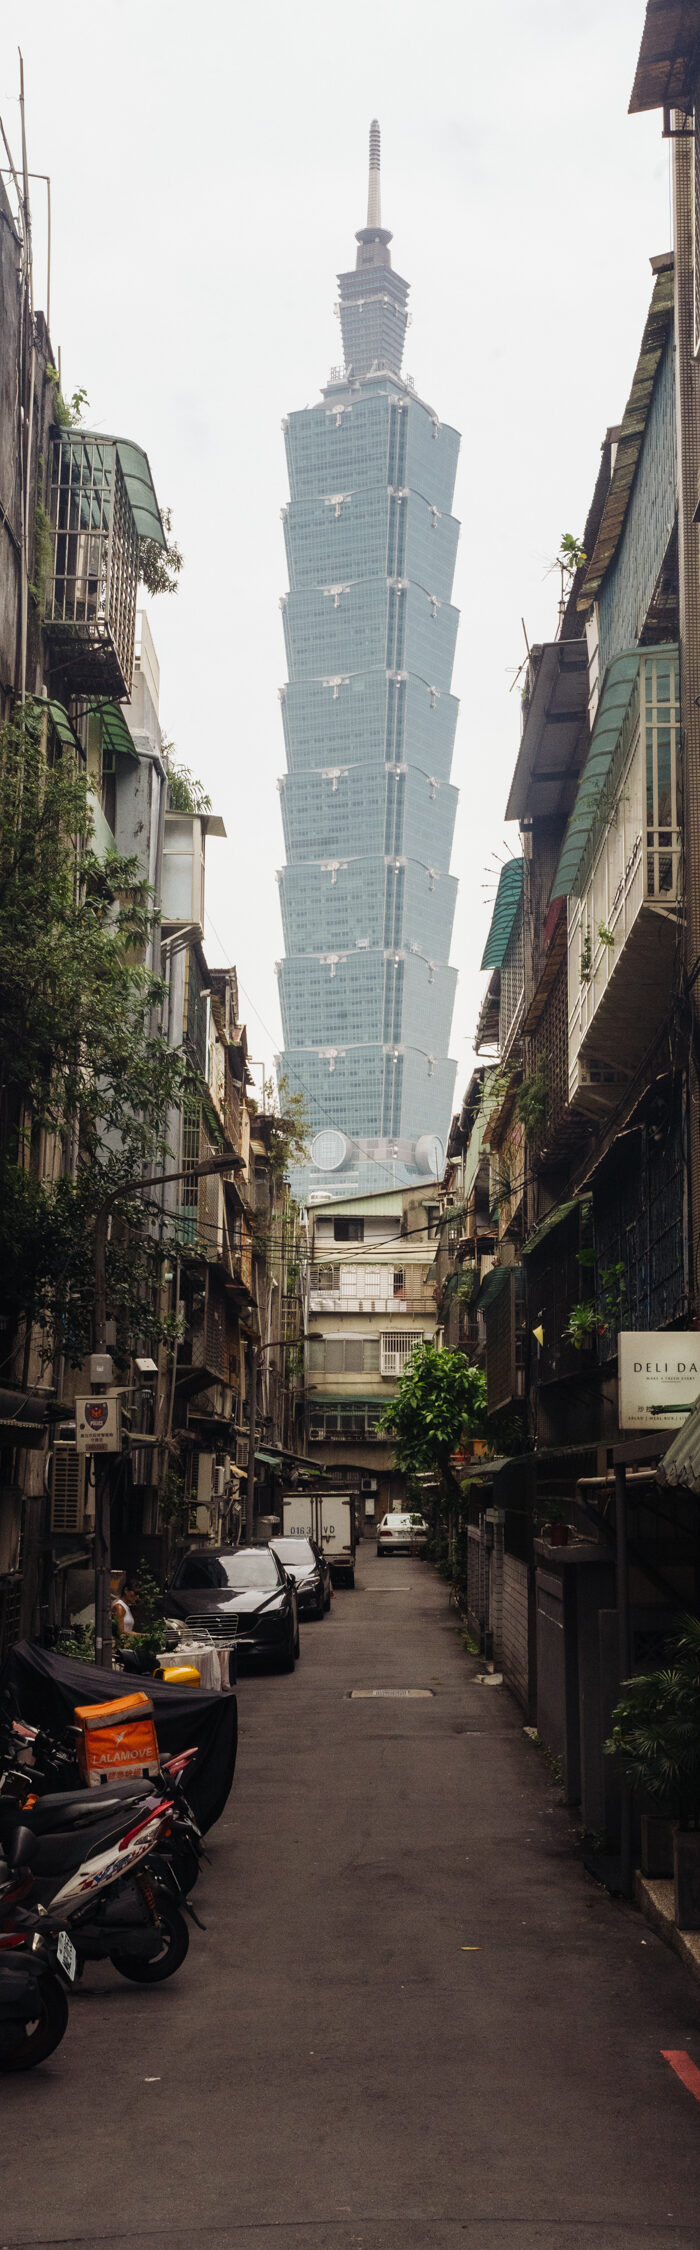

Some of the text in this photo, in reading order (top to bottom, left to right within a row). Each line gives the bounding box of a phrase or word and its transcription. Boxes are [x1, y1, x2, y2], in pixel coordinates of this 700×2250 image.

[634, 1363, 698, 1372] DELI DA
[92, 1747, 153, 1765] LALAMOVE
